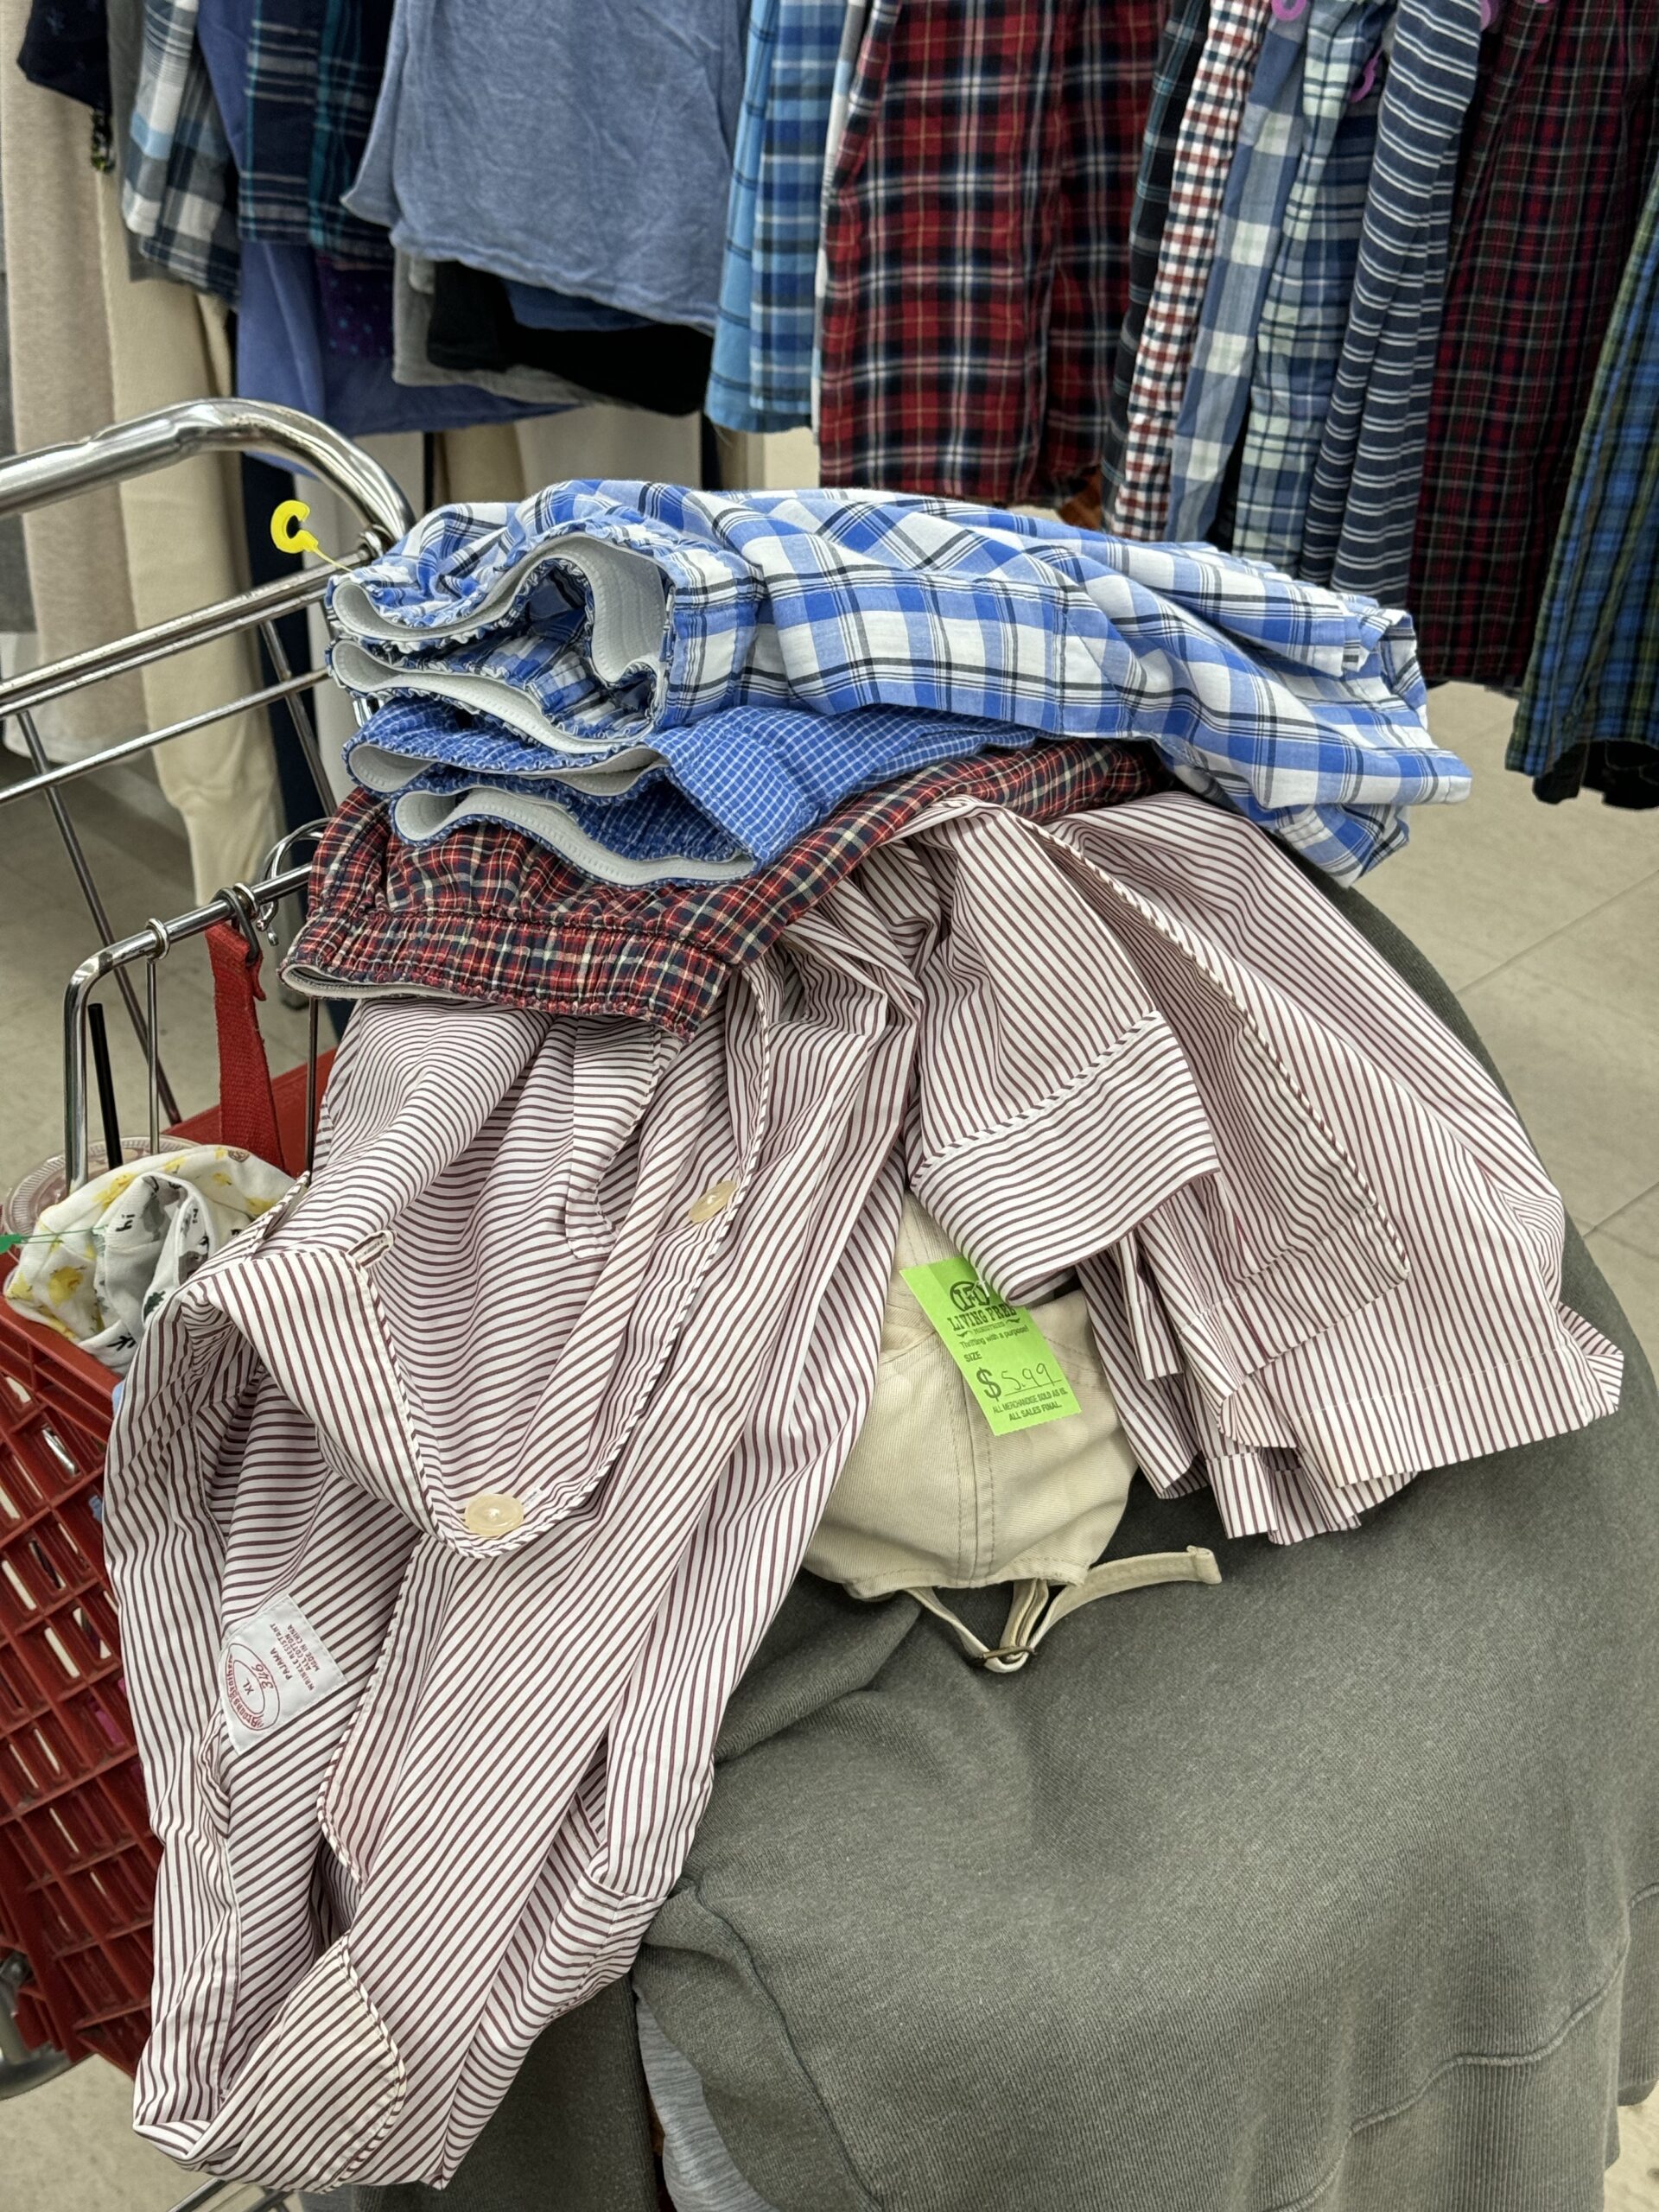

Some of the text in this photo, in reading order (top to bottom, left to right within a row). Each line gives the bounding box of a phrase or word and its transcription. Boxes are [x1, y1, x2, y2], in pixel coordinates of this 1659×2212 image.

[947, 1310, 989, 1332] LIVING
[985, 1333, 1000, 1342] with
[963, 1351, 982, 1363] SIZE
[992, 1405, 1004, 1414] ALL
[1002, 1395, 1039, 1410] MERCHANDISE
[1037, 1391, 1052, 1402] SOLD
[1052, 1389, 1061, 1398] AS
[1008, 1413, 1021, 1421] ALL
[1020, 1405, 1042, 1418] SALES
[287, 1624, 302, 1644] CHINA
[270, 1623, 315, 1691] WRINKLE RESISTANT
[284, 1633, 312, 1671] ALL COTTON
[305, 1650, 321, 1672] MADE
[270, 1647, 293, 1681] PAJAMA
[242, 1678, 255, 1695] XL
[251, 1663, 274, 1689] 346
